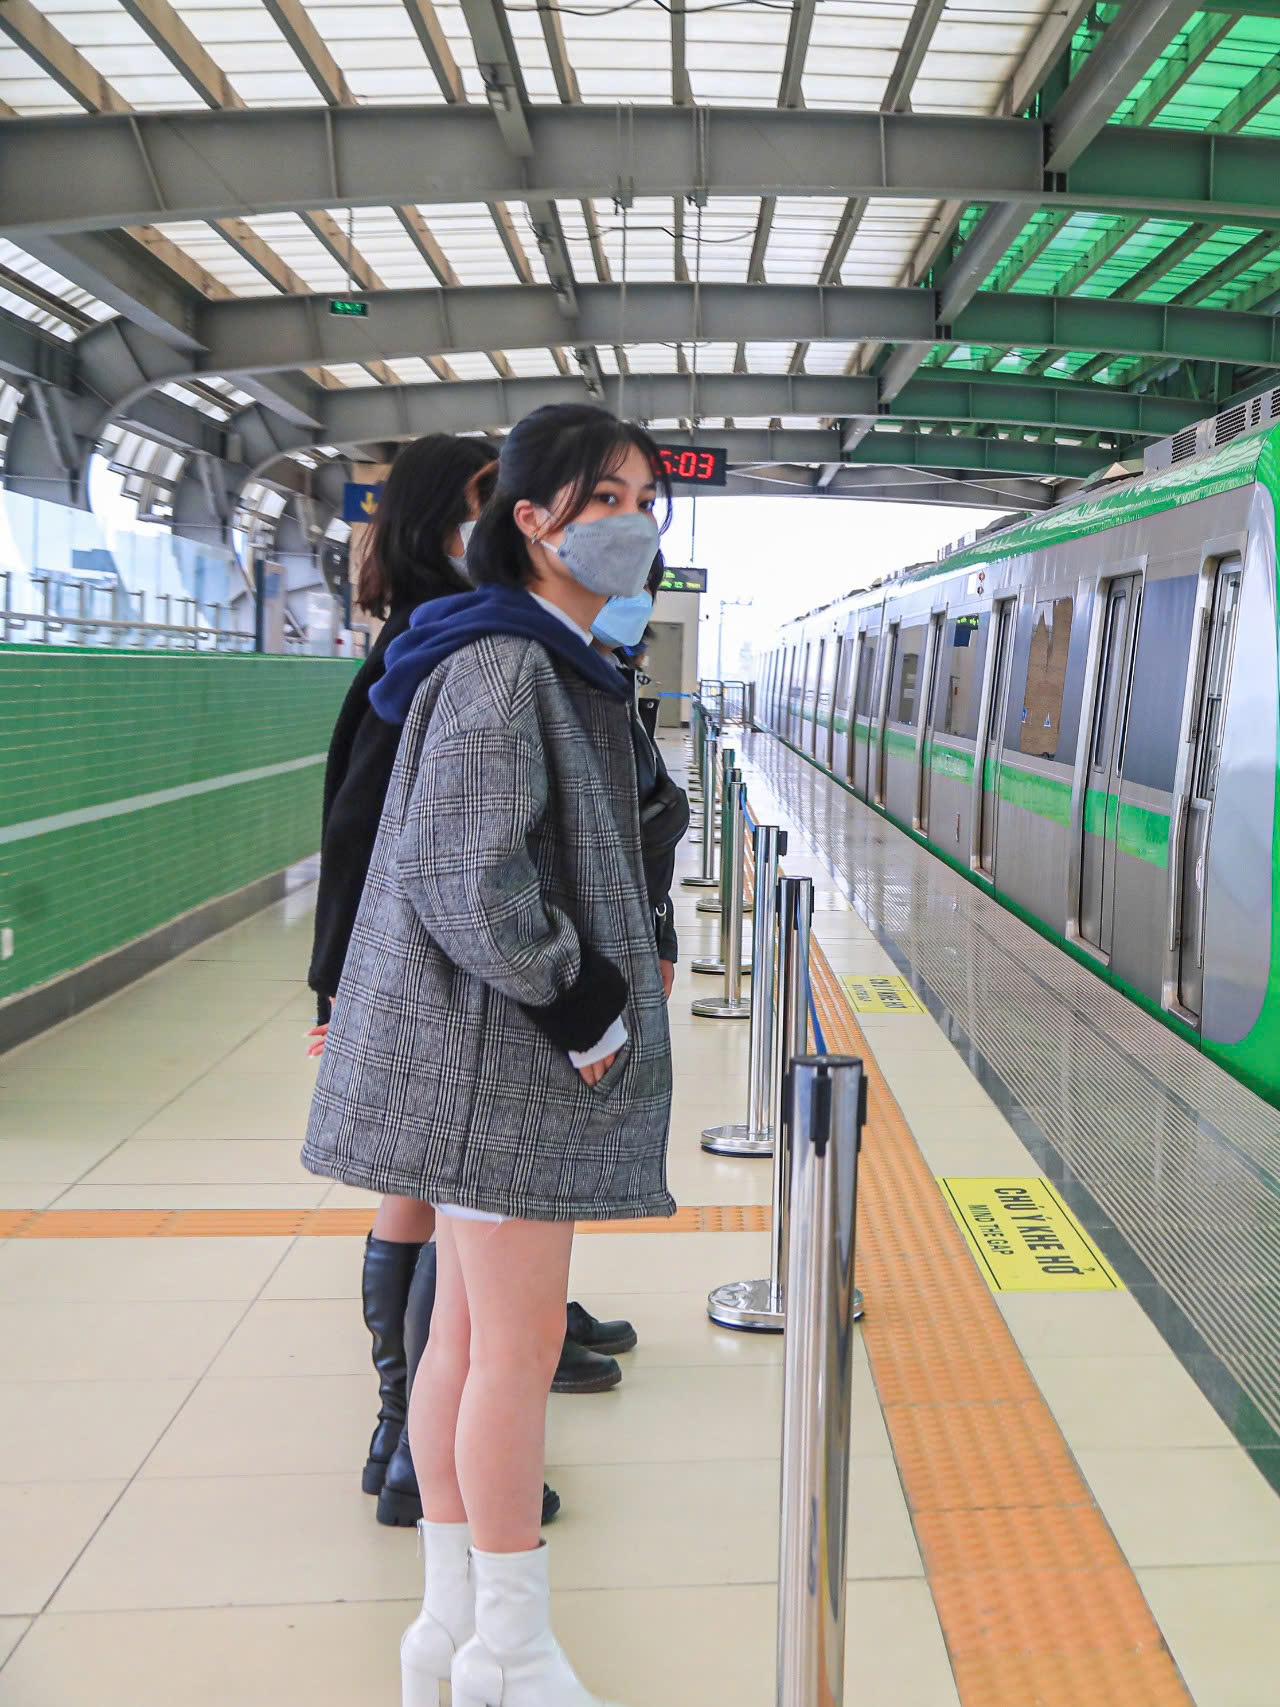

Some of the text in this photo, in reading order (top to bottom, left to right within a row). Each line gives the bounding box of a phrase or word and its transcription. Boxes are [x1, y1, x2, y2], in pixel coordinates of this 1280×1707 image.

[968, 1204, 1014, 1256] MIND THE GAP
[994, 1187, 1096, 1275] CHÚ Ý KHE HỞ
